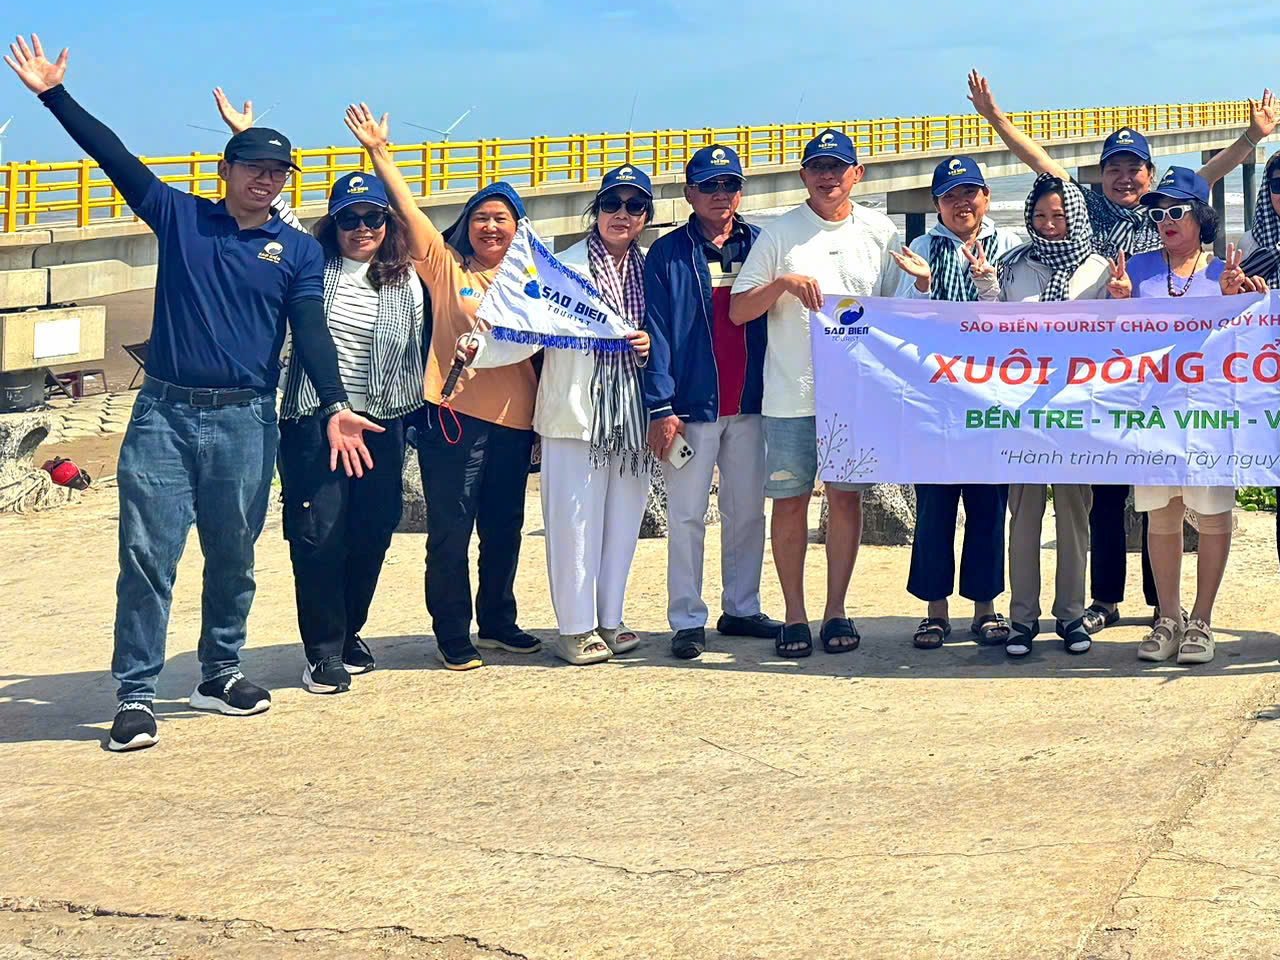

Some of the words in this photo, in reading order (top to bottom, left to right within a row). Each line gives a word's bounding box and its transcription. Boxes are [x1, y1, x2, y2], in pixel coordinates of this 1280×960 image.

[542, 286, 572, 308] SAO
[824, 326, 845, 335] SAO
[960, 321, 993, 332] SAO
[1044, 321, 1115, 332] TOURIST
[1120, 318, 1168, 332] CHÀO
[1174, 318, 1212, 332] ĐÓN
[1218, 312, 1253, 330] QUÝ
[929, 348, 1053, 385] XUÔI
[1066, 349, 1205, 385] DÒNG
[965, 404, 1020, 429] BẾN
[1028, 409, 1084, 429] TRE
[1108, 406, 1166, 429] TRÀ
[1174, 409, 1240, 429] VINH
[1070, 450, 1118, 465] trình
[1124, 448, 1177, 465] miền
[1185, 450, 1222, 469] Tây
